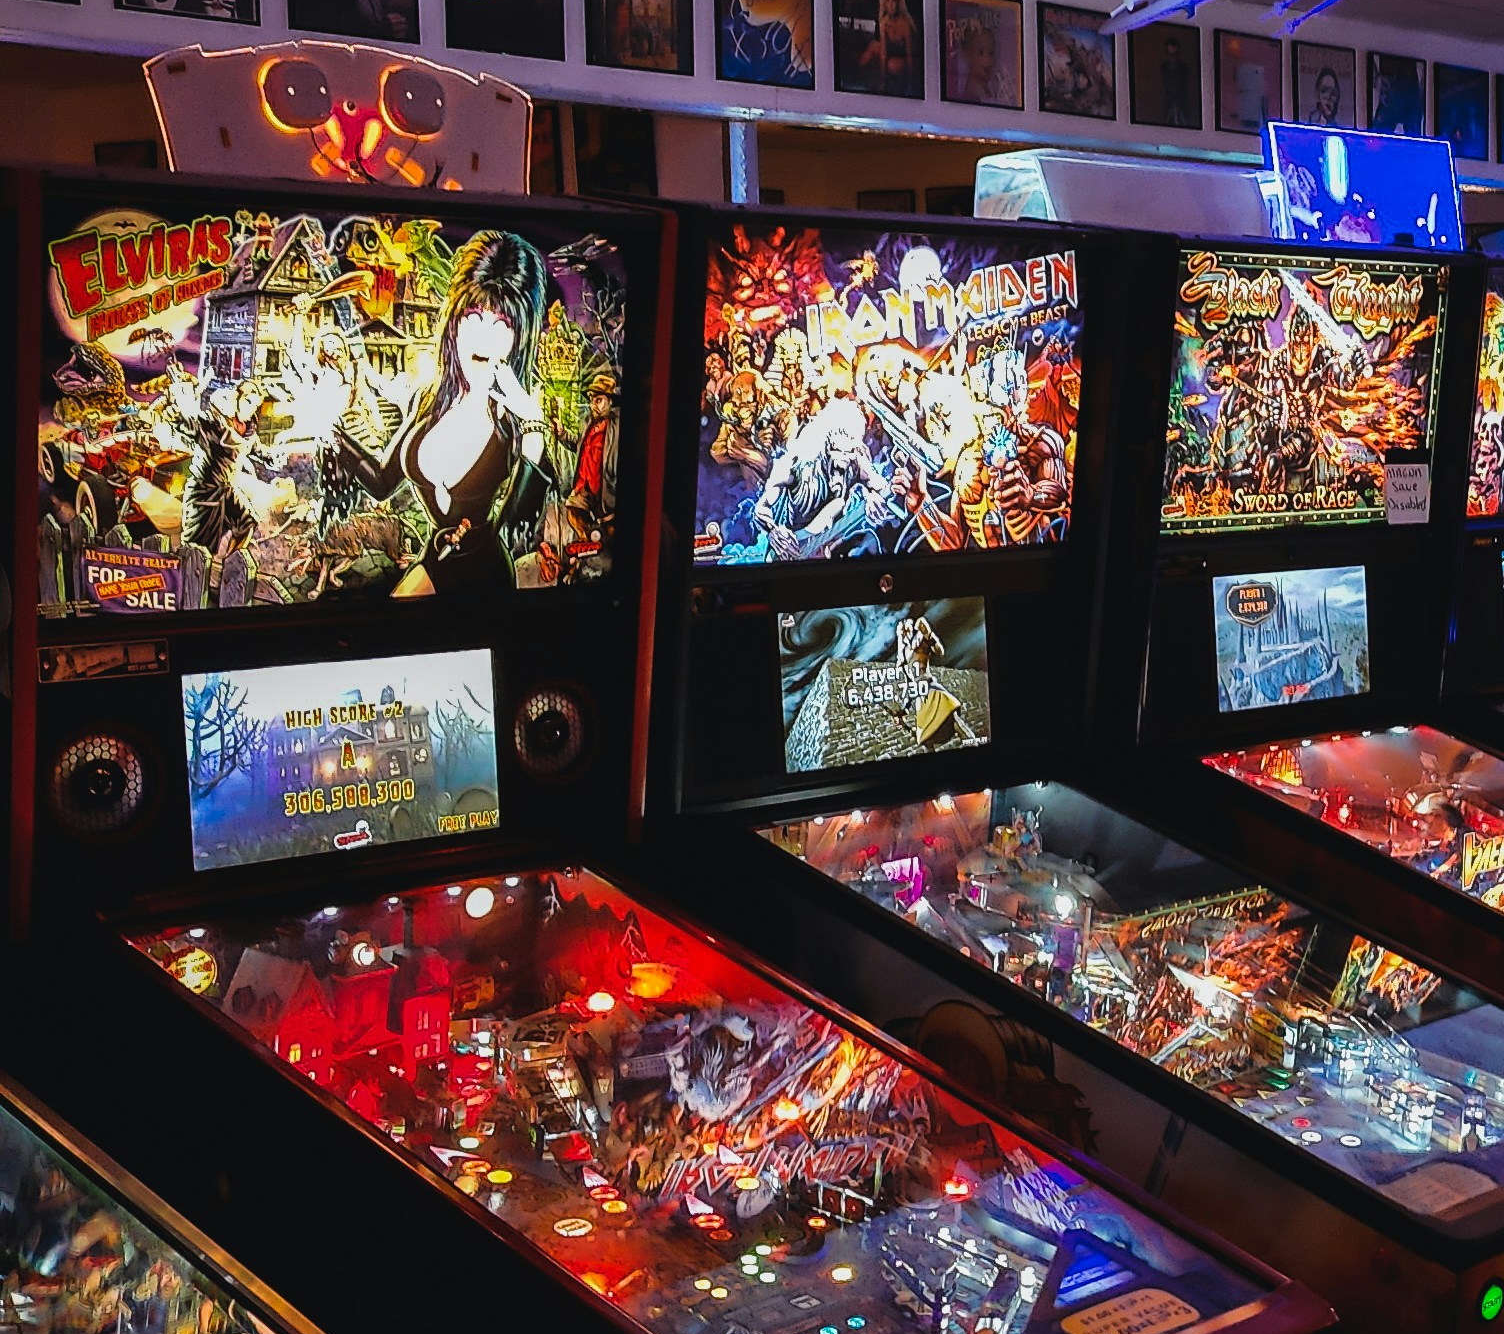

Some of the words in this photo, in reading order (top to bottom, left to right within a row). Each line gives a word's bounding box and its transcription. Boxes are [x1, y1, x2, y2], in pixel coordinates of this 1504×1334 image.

[806, 287, 919, 359] IRON
[914, 250, 1078, 335] MAIDEN
[968, 317, 1018, 342] LEGACY
[1030, 304, 1069, 326] BEAST
[1233, 487, 1288, 514] SWORD
[1293, 492, 1313, 510] OF
[1313, 485, 1358, 509] RAGE
[87, 565, 127, 584] FOR
[126, 591, 176, 611] SALE
[852, 667, 903, 685] Player
[847, 680, 930, 706] 6,438,730
[285, 707, 323, 730] HIGH
[329, 703, 376, 726] SCORE
[340, 739, 356, 770] A
[438, 815, 466, 832] FREE
[468, 809, 499, 828] PLAY
